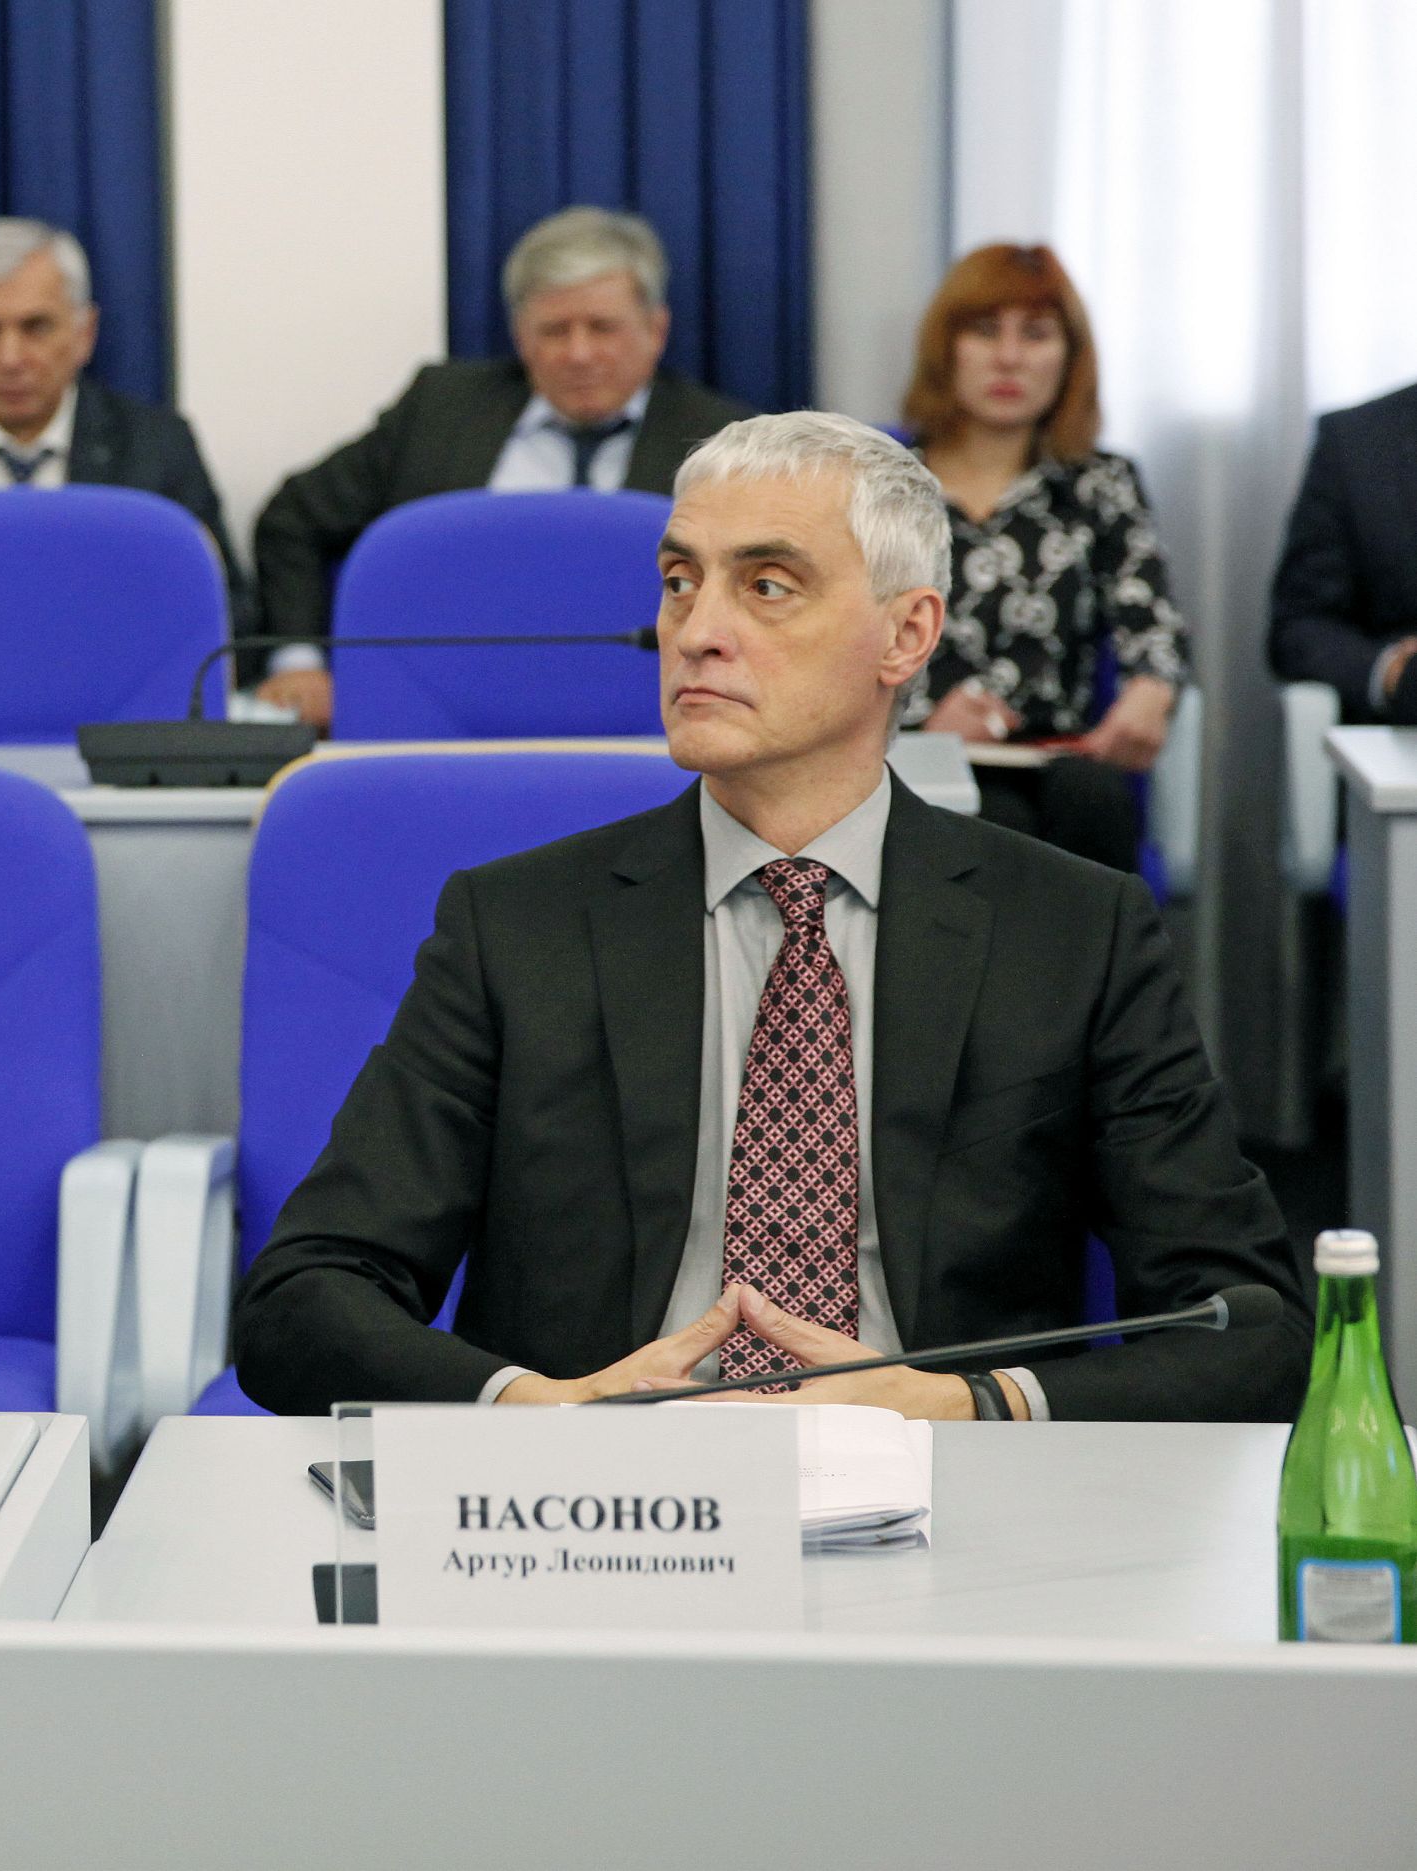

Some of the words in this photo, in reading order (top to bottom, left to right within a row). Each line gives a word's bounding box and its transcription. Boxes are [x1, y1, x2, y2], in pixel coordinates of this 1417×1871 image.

[456, 1494, 722, 1533] НАСОНОВ
[442, 1549, 537, 1578] Артур
[547, 1549, 736, 1575] Леонидович
